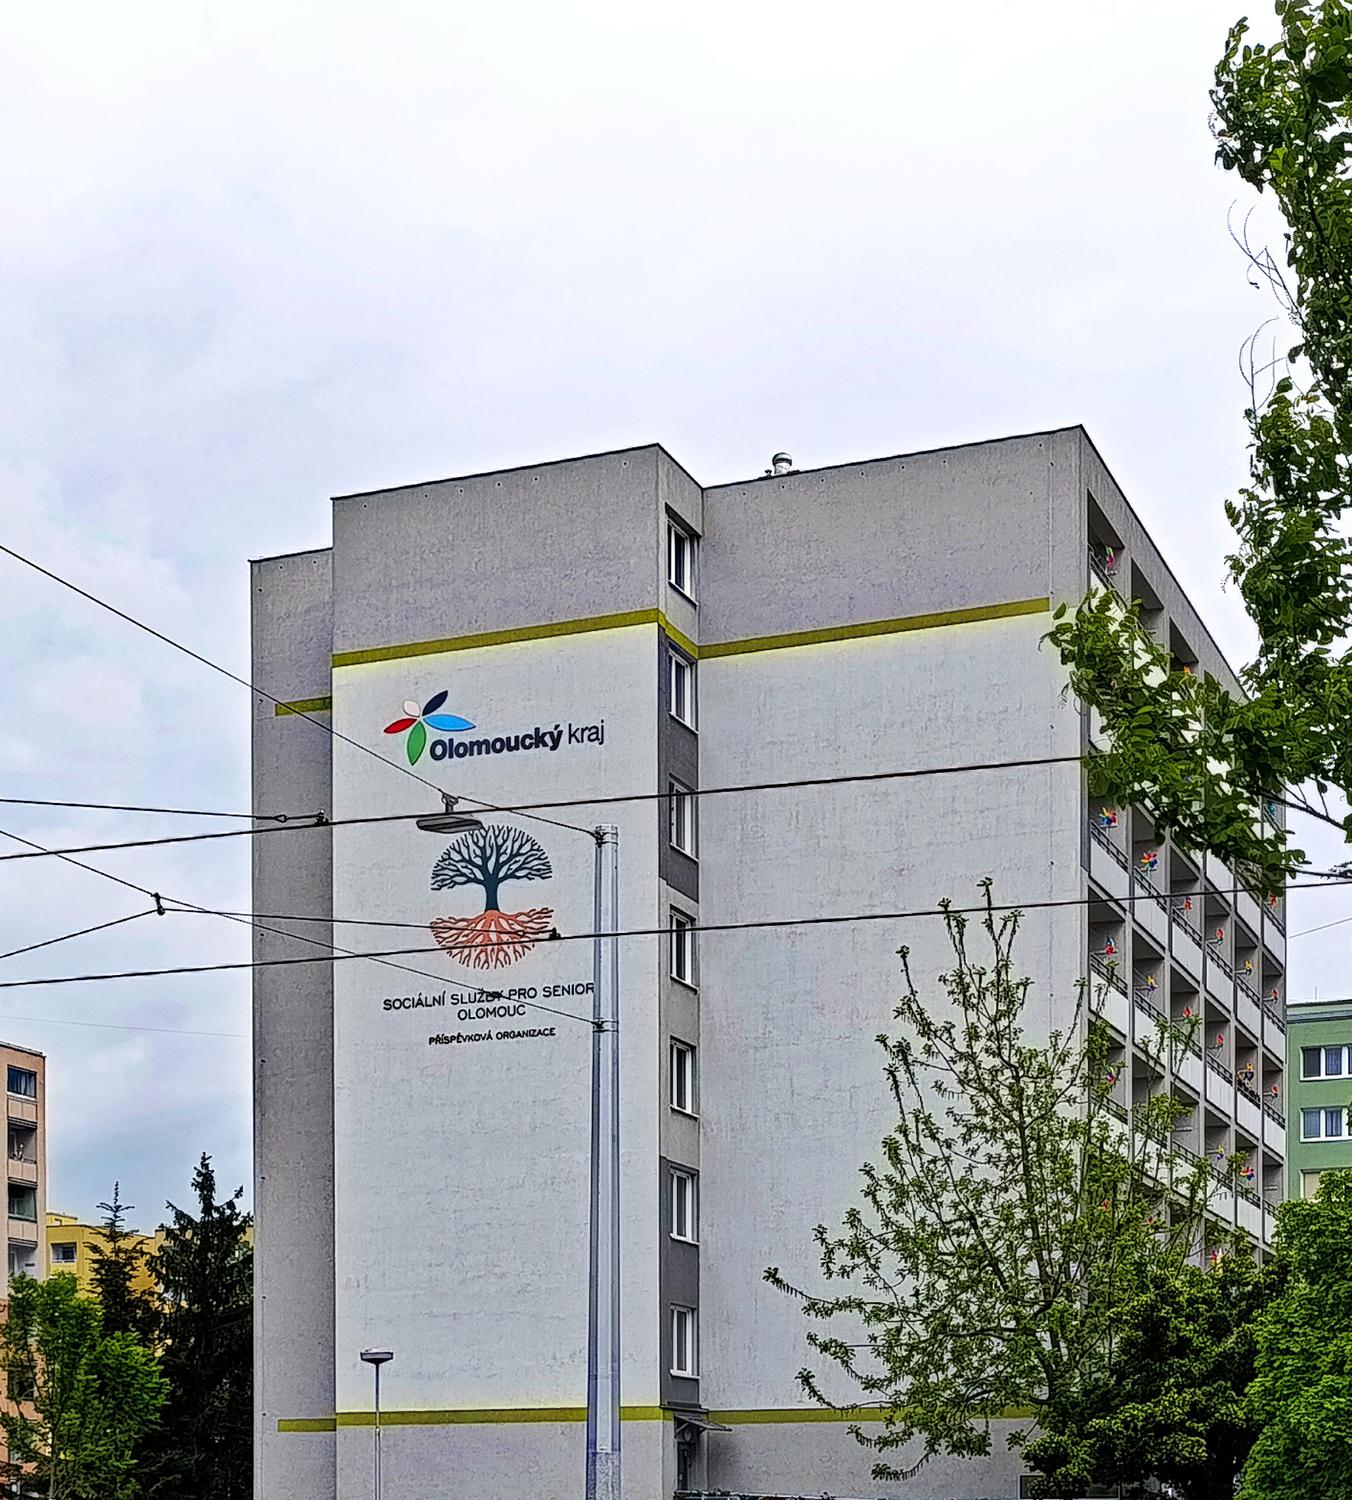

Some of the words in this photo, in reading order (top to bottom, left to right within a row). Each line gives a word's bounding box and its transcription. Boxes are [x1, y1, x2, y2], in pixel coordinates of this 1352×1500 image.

[429, 724, 563, 761] Olomoucký
[568, 719, 604, 745] kraj
[383, 990, 446, 1011] SOCIÁLNÍ
[508, 987, 537, 1000] PRO
[542, 982, 595, 998] SENIOR
[457, 1004, 526, 1021] OLOMOUC
[495, 1027, 556, 1041] ORGANIZACE
